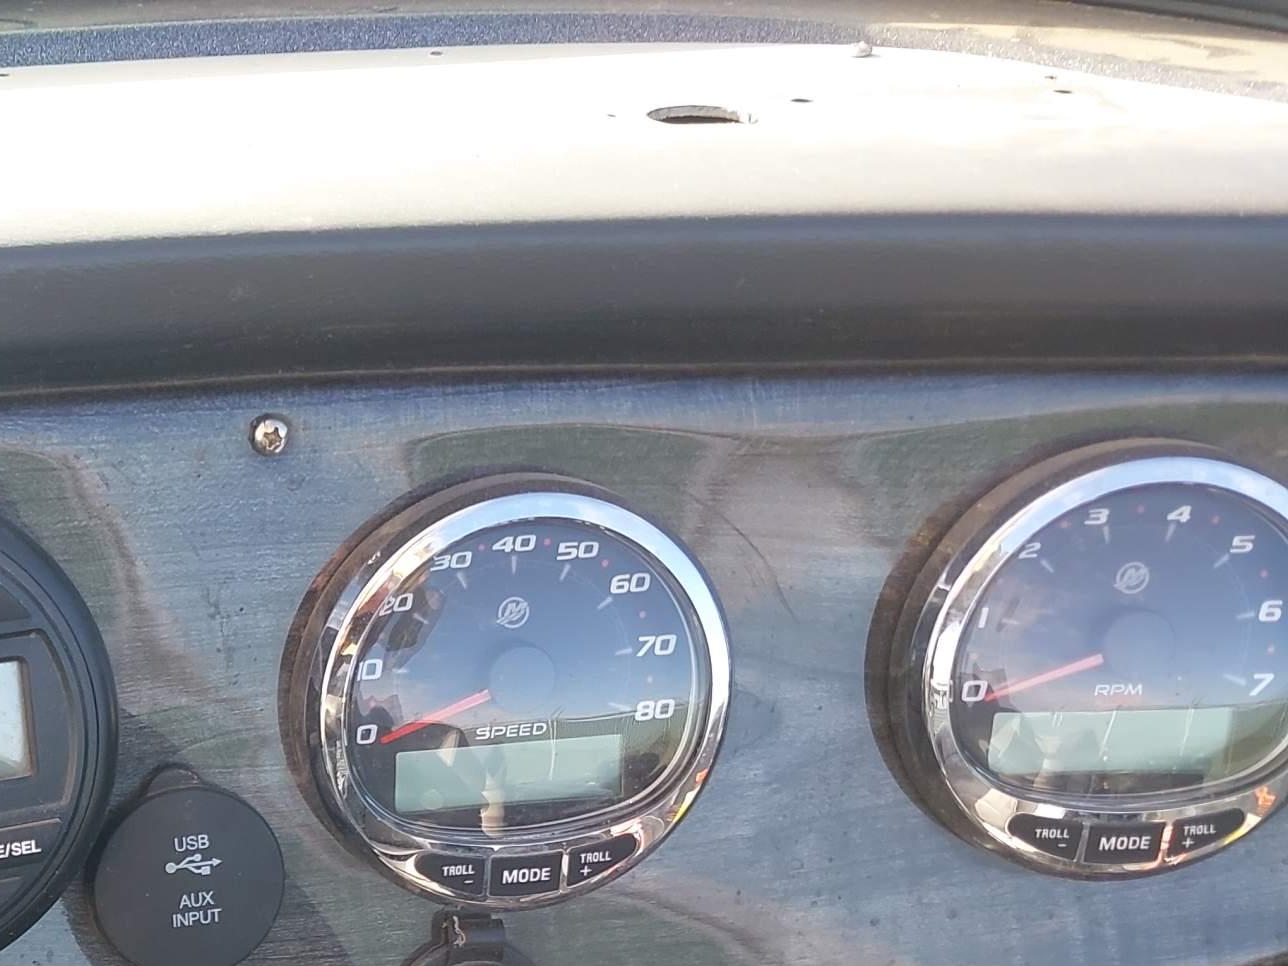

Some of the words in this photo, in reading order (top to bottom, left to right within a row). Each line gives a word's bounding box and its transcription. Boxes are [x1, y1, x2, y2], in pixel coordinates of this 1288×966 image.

[1084, 509, 1109, 526] 3
[1167, 505, 1192, 523] 4
[492, 534, 537, 554] 40
[557, 541, 599, 560] 50
[1018, 542, 1041, 559] 2
[1230, 535, 1256, 553] 5
[430, 551, 472, 572] 30
[610, 573, 651, 593] 60
[379, 593, 413, 616] 20
[1258, 600, 1283, 622] 6
[636, 635, 677, 656] 70
[961, 680, 988, 702] 0
[1094, 683, 1143, 697] RPM
[1249, 673, 1274, 697] 7
[634, 700, 675, 721] 80
[356, 724, 378, 744] 0
[475, 722, 547, 740] SPEED
[1035, 829, 1070, 839] TROLL
[1183, 824, 1216, 836] TROLL
[173, 834, 210, 852] USB
[1098, 835, 1151, 851] MODE
[580, 851, 612, 864] TROLL
[442, 865, 475, 877] TROLL
[502, 867, 551, 884] MODE
[179, 891, 214, 910] AUX
[172, 908, 221, 927] INPUT
